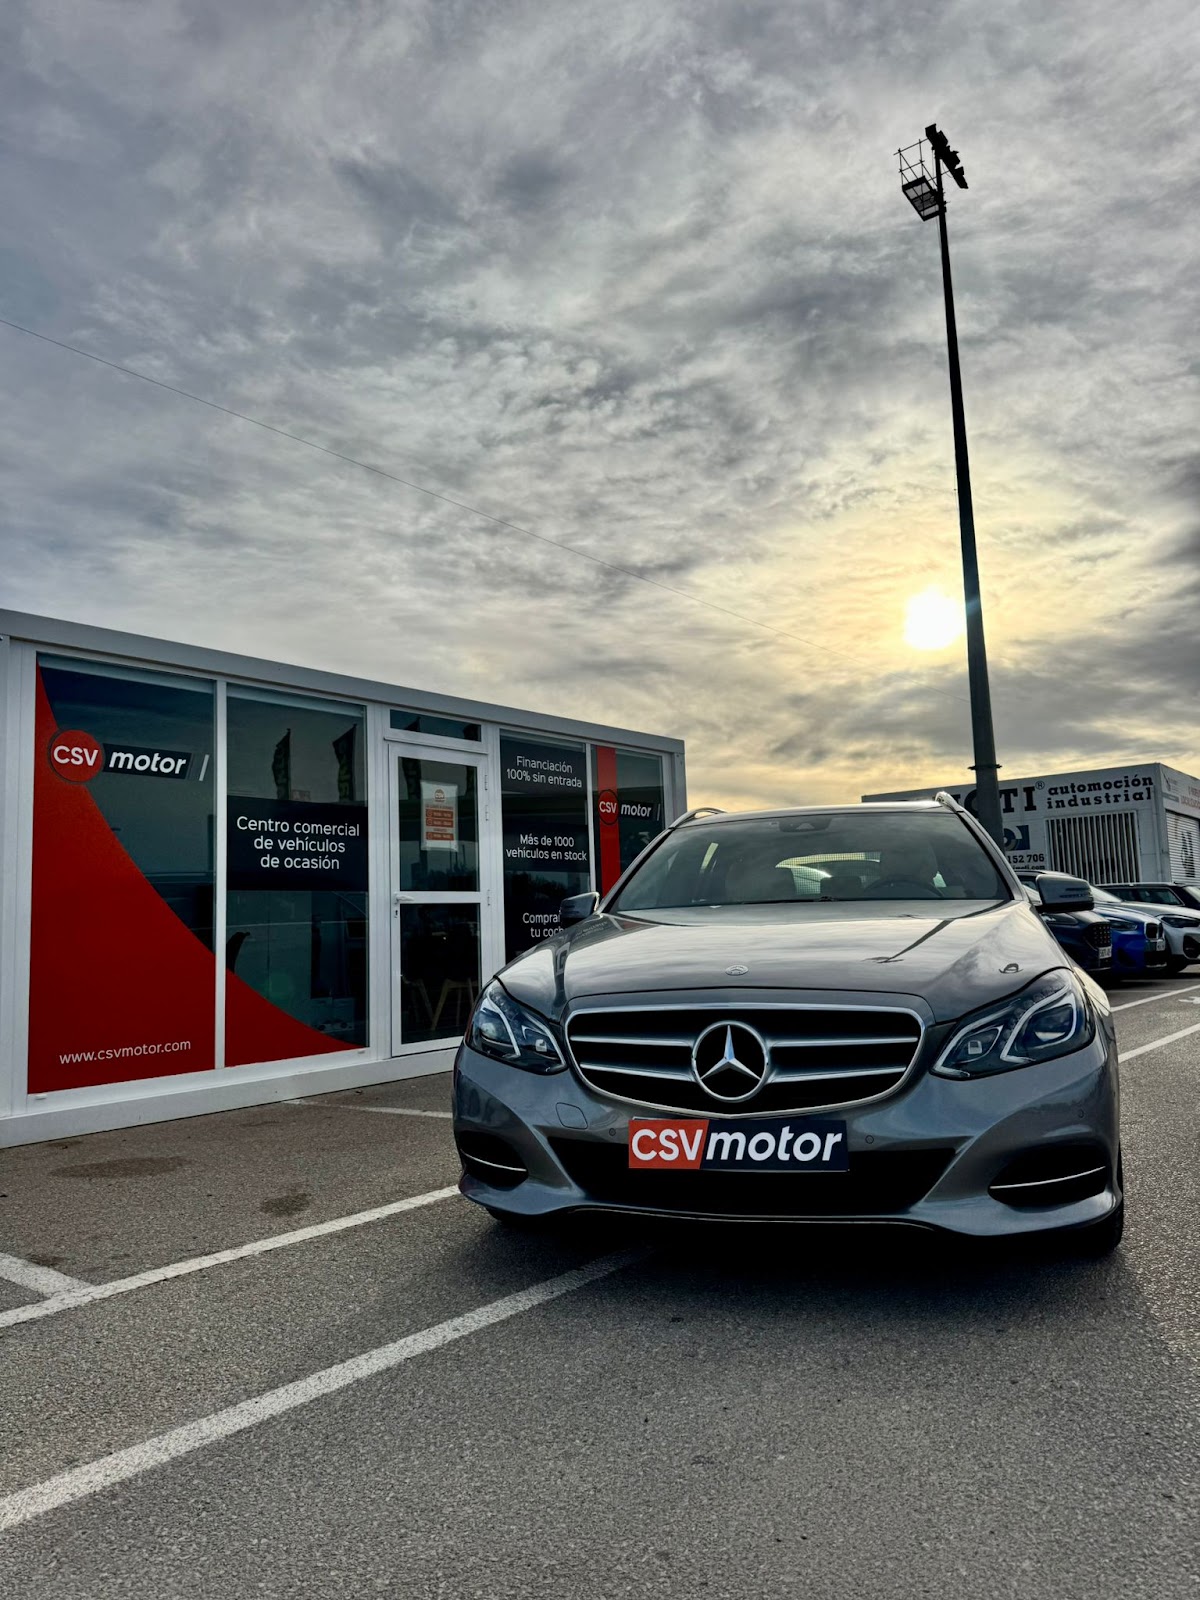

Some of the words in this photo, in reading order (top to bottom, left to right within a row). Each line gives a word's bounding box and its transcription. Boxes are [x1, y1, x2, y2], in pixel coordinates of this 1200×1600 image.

[53, 745, 98, 766] CSV
[109, 751, 187, 774] motor
[516, 755, 573, 773] Financiación
[506, 768, 531, 781] 100%
[532, 772, 546, 783] sin
[548, 775, 582, 788] entrada
[1048, 774, 1153, 796] automoción
[1047, 787, 1151, 809] industrial
[599, 801, 617, 814] CSV
[620, 803, 652, 817] motor
[236, 816, 290, 832] Centro
[293, 823, 360, 836] comercial
[253, 835, 274, 849] de
[278, 837, 346, 853] vehículos
[520, 833, 539, 846] Más
[540, 835, 552, 846] de
[553, 836, 575, 847] 1000
[260, 854, 280, 868] de
[284, 855, 340, 869] ocasión
[505, 846, 549, 860] vehículos
[550, 851, 562, 860] en
[564, 850, 587, 861] stock
[1027, 853, 1045, 863] 706
[530, 926, 541, 938] tu
[59, 1040, 191, 1065] www.csvmotor.com
